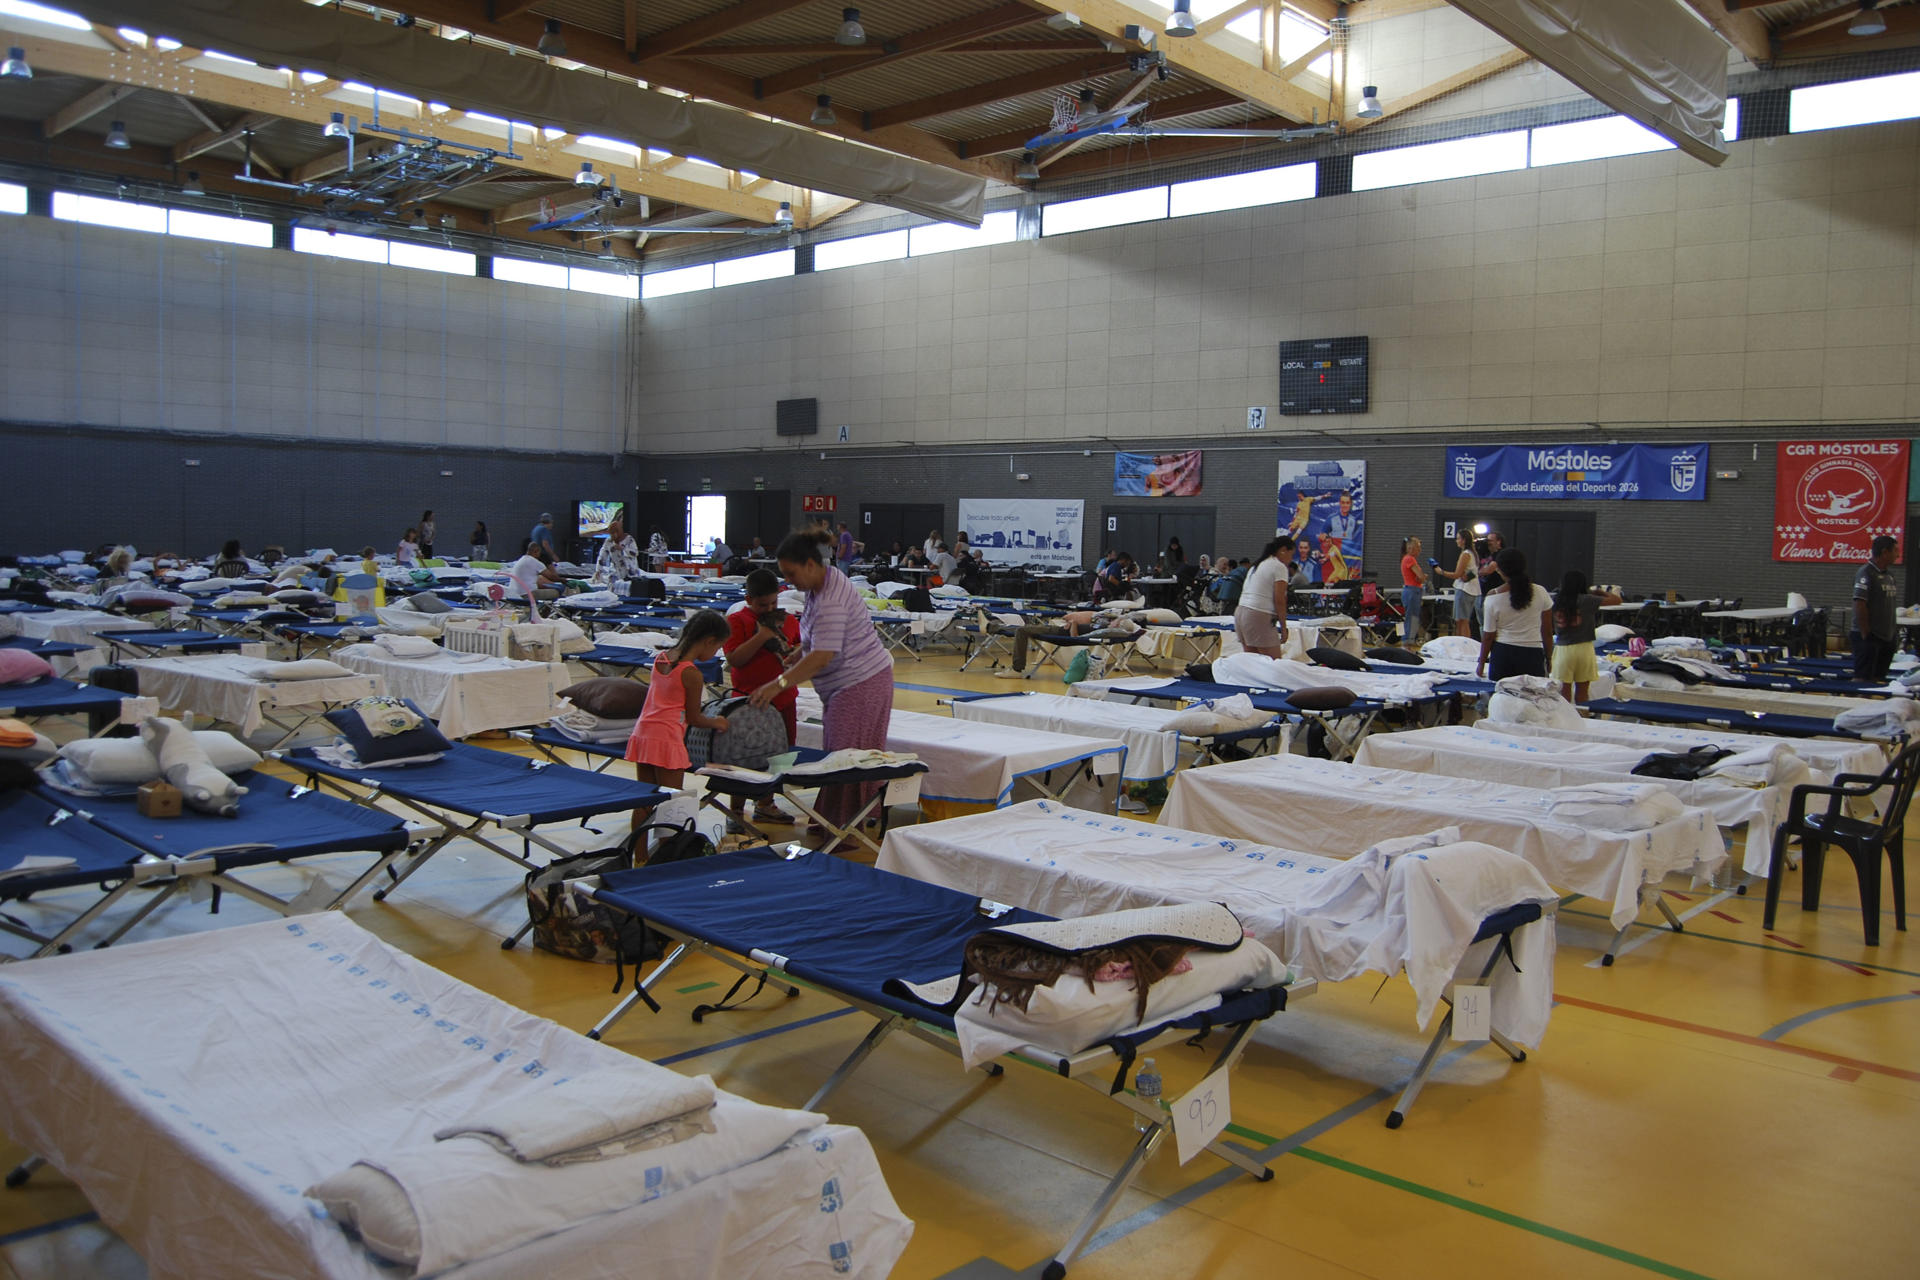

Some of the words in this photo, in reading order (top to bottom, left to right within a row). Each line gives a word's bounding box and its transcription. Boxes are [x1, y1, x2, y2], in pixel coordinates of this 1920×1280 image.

[1282, 361, 1305, 369] LOCAL
[839, 426, 848, 441] A
[1786, 444, 1815, 456] CGR
[1819, 442, 1899, 455] MÓSTOLES
[1528, 449, 1612, 471] Móstoles
[1804, 467, 1820, 481] CLUB
[1500, 482, 1528, 492] Ciudad
[1530, 482, 1564, 494] Europea
[1566, 482, 1580, 492] del
[1582, 482, 1617, 494] Deporte
[1618, 482, 1639, 492] 2026
[1109, 519, 1115, 529] 3
[1446, 525, 1454, 536] 2
[1780, 542, 1824, 558] Vamos
[1829, 541, 1873, 560] Chicas
[1462, 994, 1479, 1029] 94
[1189, 1089, 1217, 1134] 93
